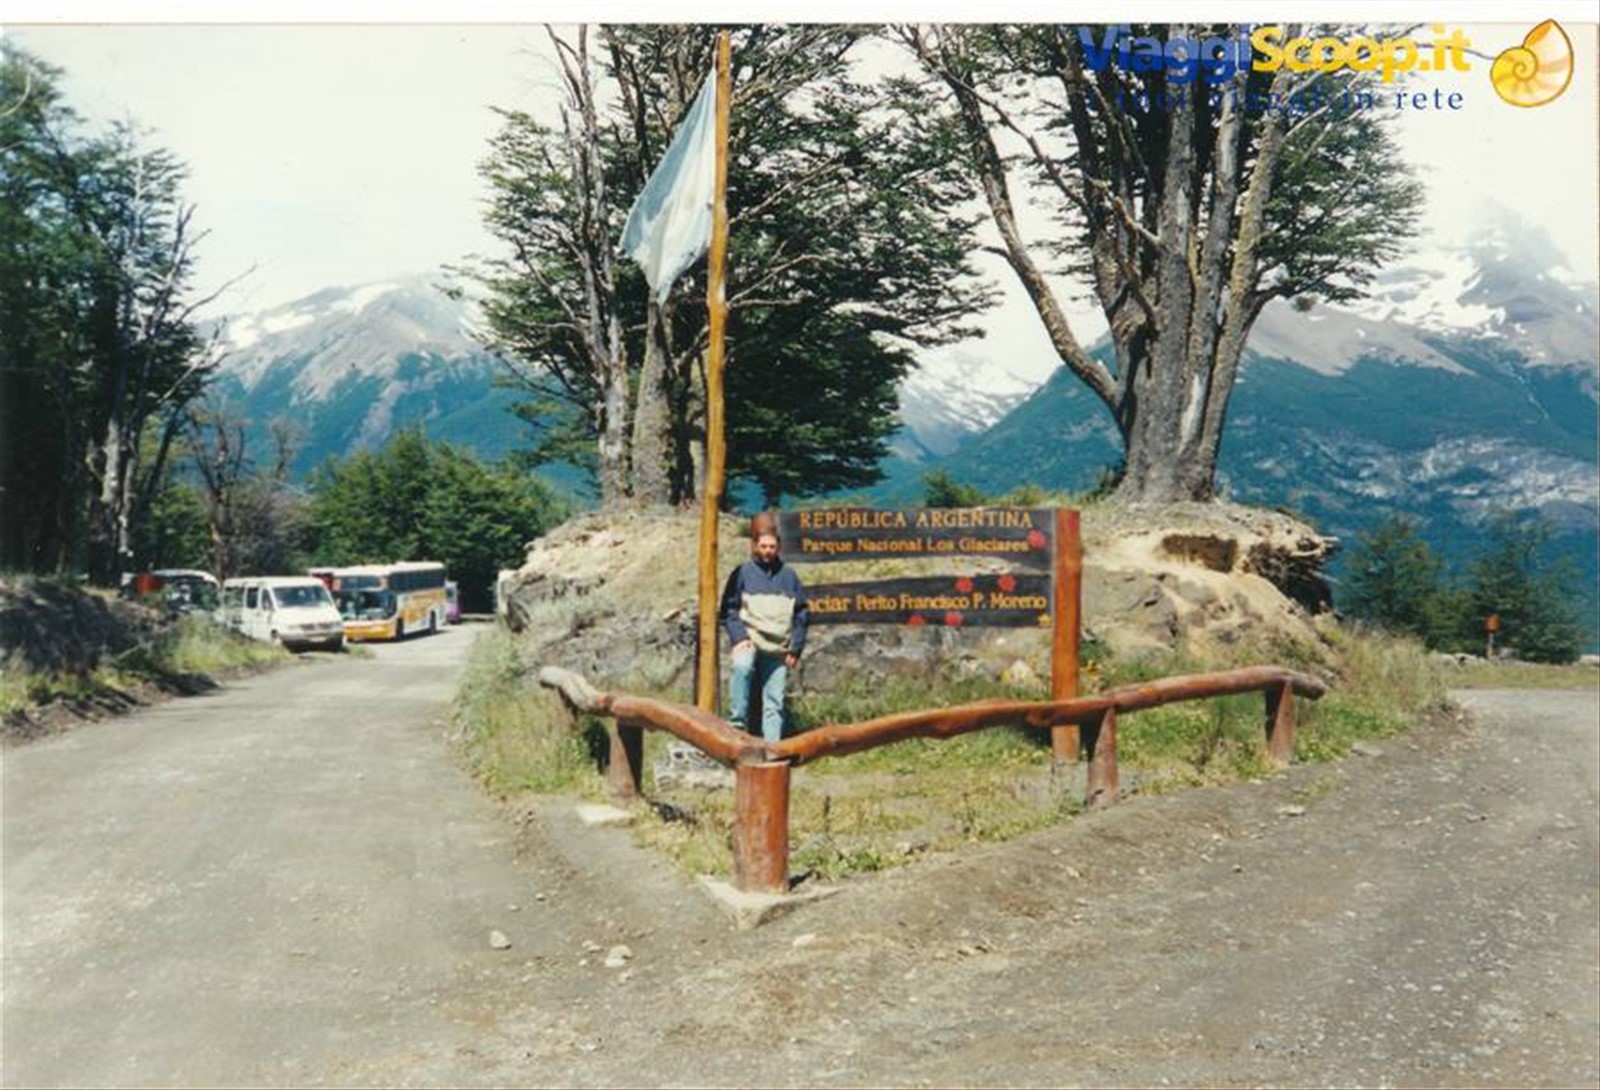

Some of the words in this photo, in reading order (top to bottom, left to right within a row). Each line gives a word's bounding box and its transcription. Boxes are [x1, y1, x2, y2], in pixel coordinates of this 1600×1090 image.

[916, 509, 1033, 529] ARGENTINA
[802, 538, 853, 554] Parque
[857, 538, 922, 552] Nacional
[926, 538, 954, 552] Los
[959, 537, 1029, 552] Glaciares
[856, 594, 897, 611] Perito
[900, 592, 969, 610] Francisco
[972, 591, 987, 609] P.
[990, 592, 1047, 609] Moreno
